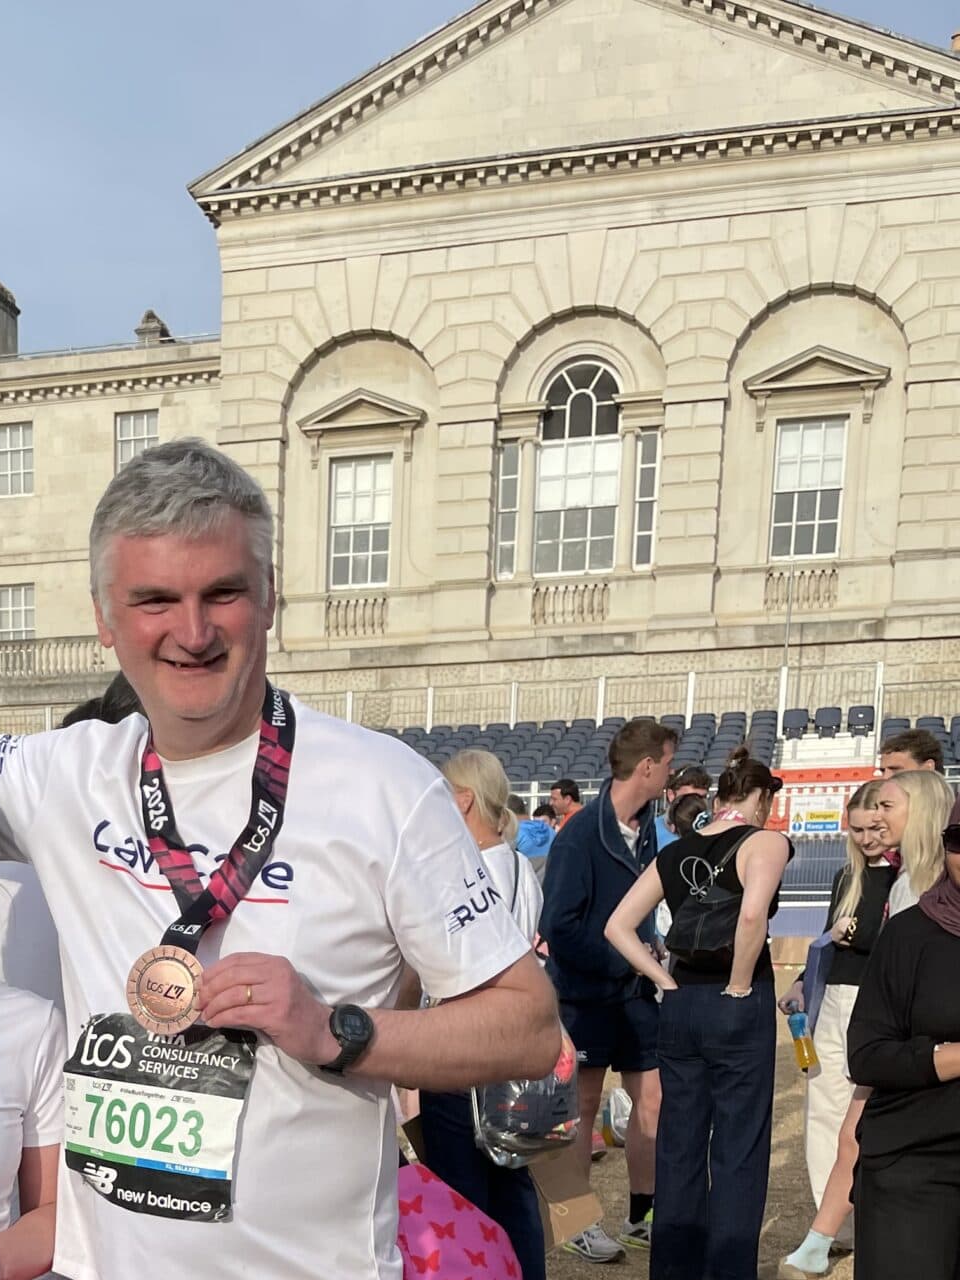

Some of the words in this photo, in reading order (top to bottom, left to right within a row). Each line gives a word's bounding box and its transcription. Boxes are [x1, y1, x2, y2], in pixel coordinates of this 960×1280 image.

[142, 778, 169, 831] 2026
[80, 1024, 136, 1069] tcs
[141, 1044, 241, 1071] CONSULTANCY
[137, 1059, 200, 1080] SERVICES
[85, 1093, 205, 1158] 76023
[116, 1187, 146, 1204] new
[147, 1190, 213, 1214] balance
